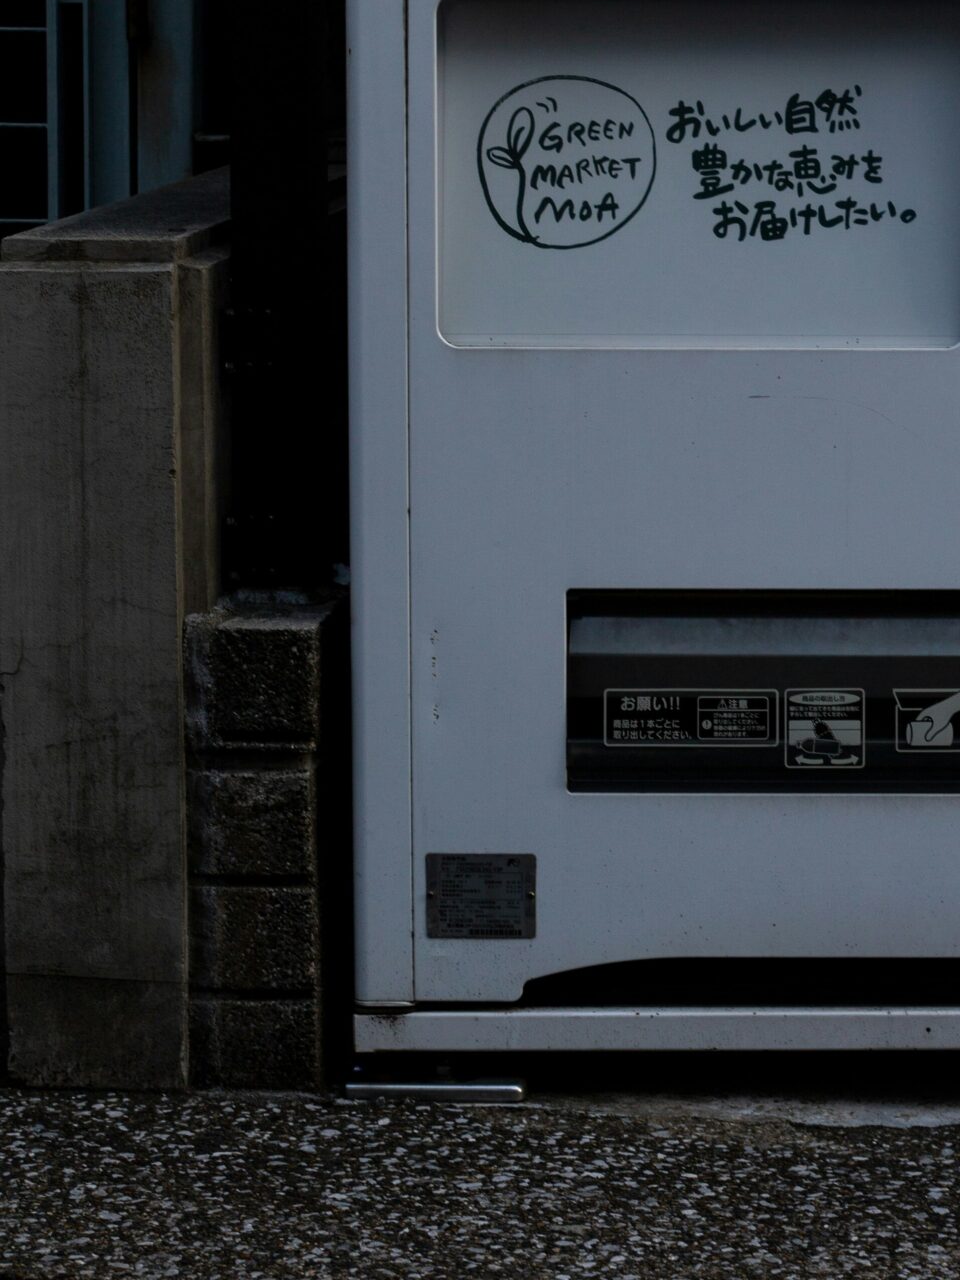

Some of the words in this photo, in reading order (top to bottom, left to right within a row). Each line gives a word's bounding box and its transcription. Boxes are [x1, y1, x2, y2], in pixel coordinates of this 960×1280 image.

[666, 85, 862, 143] おいしい自然
[538, 120, 634, 152] GREEN
[530, 156, 642, 190] MARKET
[692, 144, 883, 199] 豊かな恵みを
[535, 193, 619, 223] MOA
[713, 196, 916, 241] お届けしたい。
[728, 699, 748, 709] 注意
